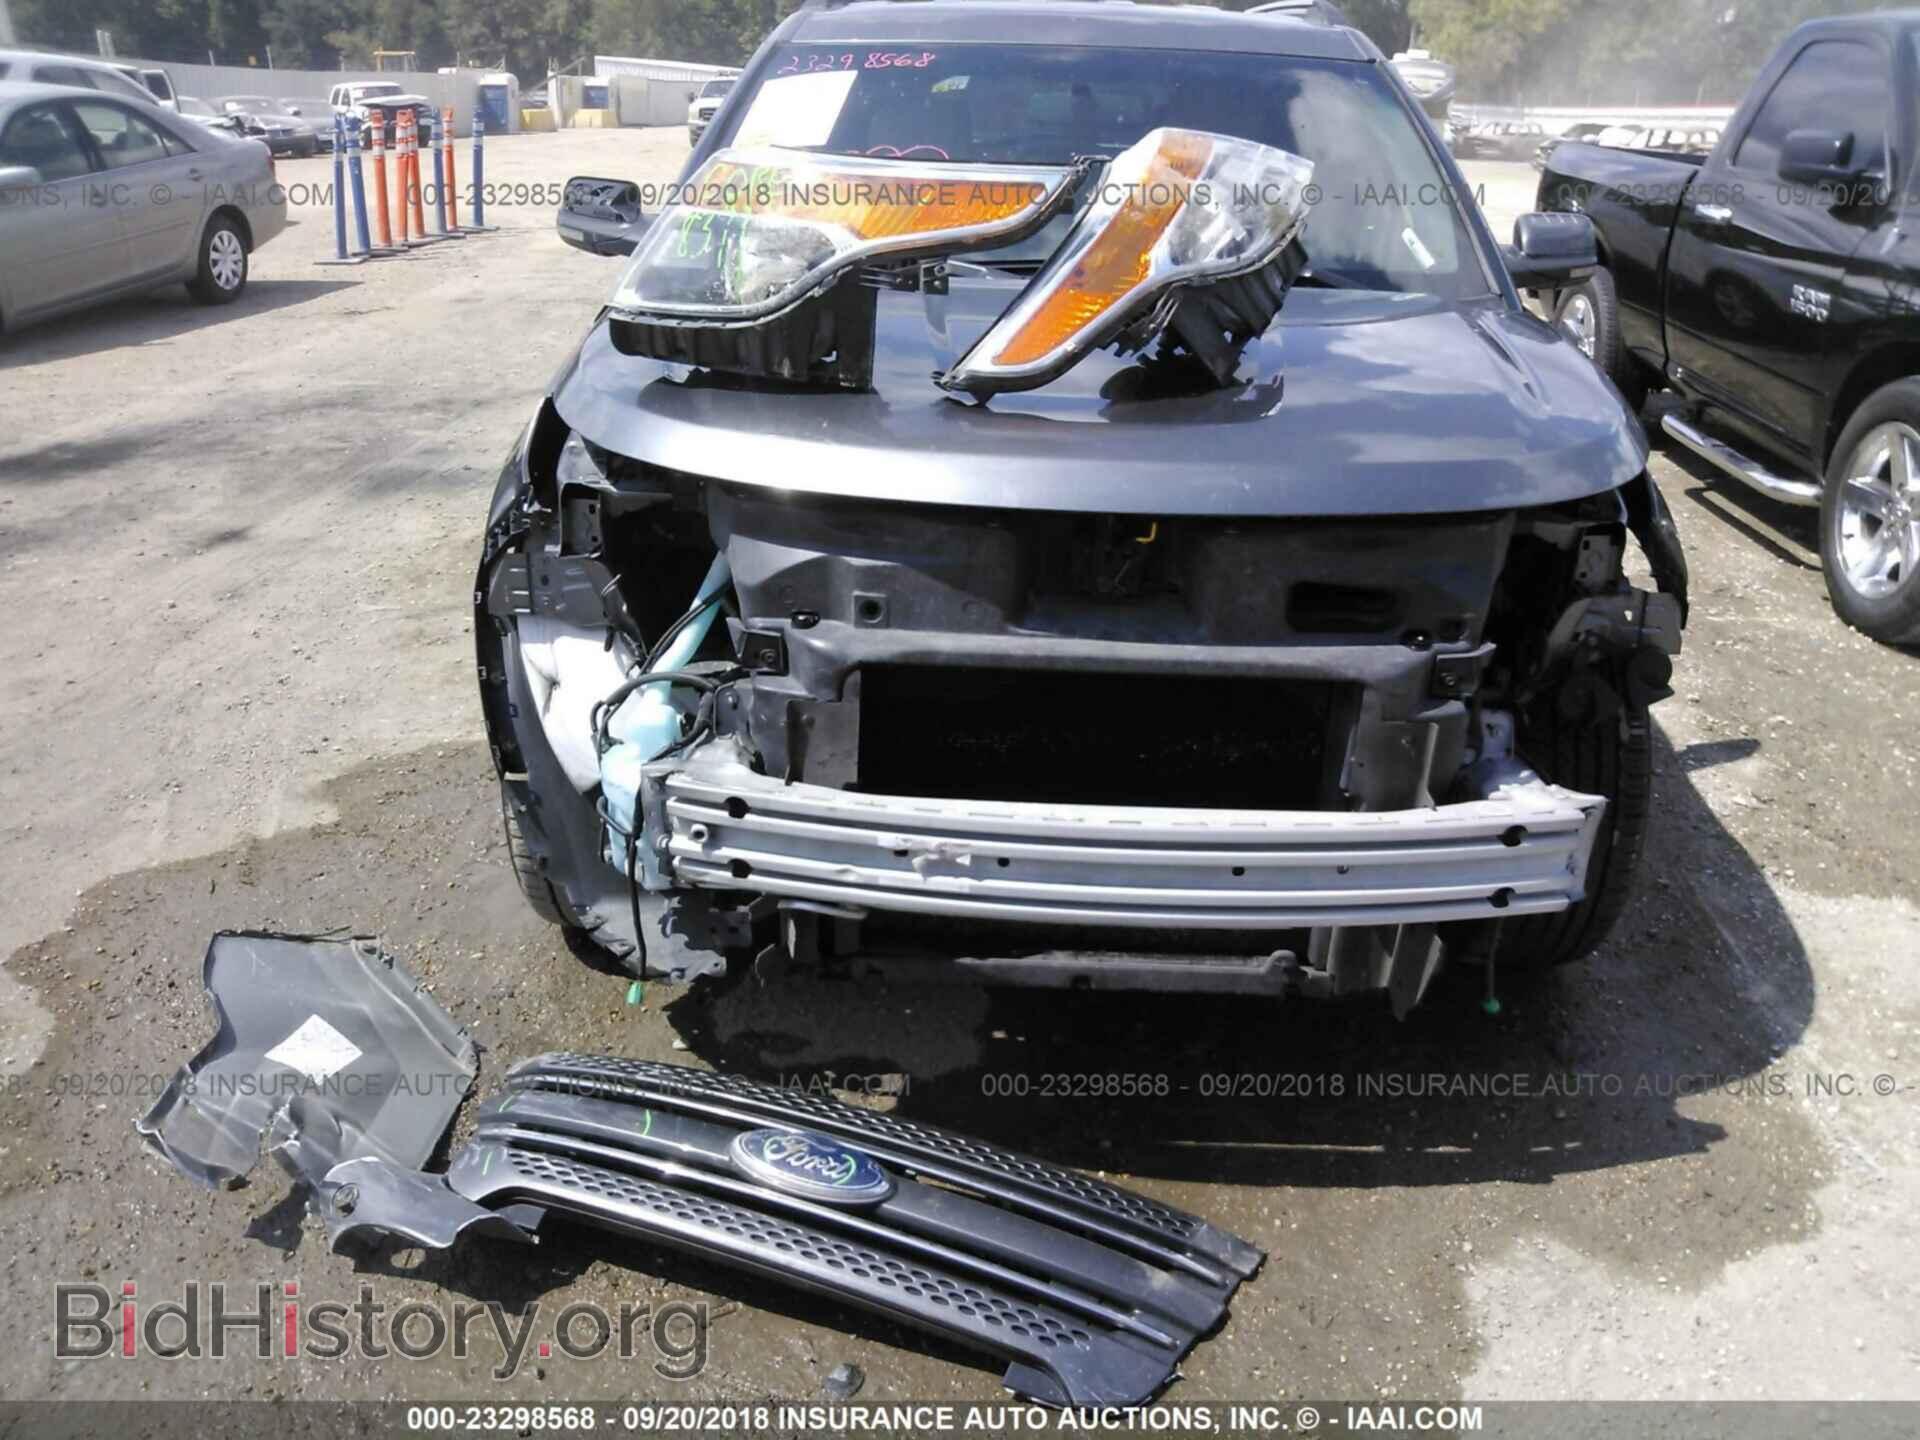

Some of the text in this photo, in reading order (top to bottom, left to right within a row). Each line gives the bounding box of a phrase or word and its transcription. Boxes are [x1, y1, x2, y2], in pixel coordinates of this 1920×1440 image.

[777, 52, 936, 75] 2329 8568
[764, 1132, 852, 1179] Ford
